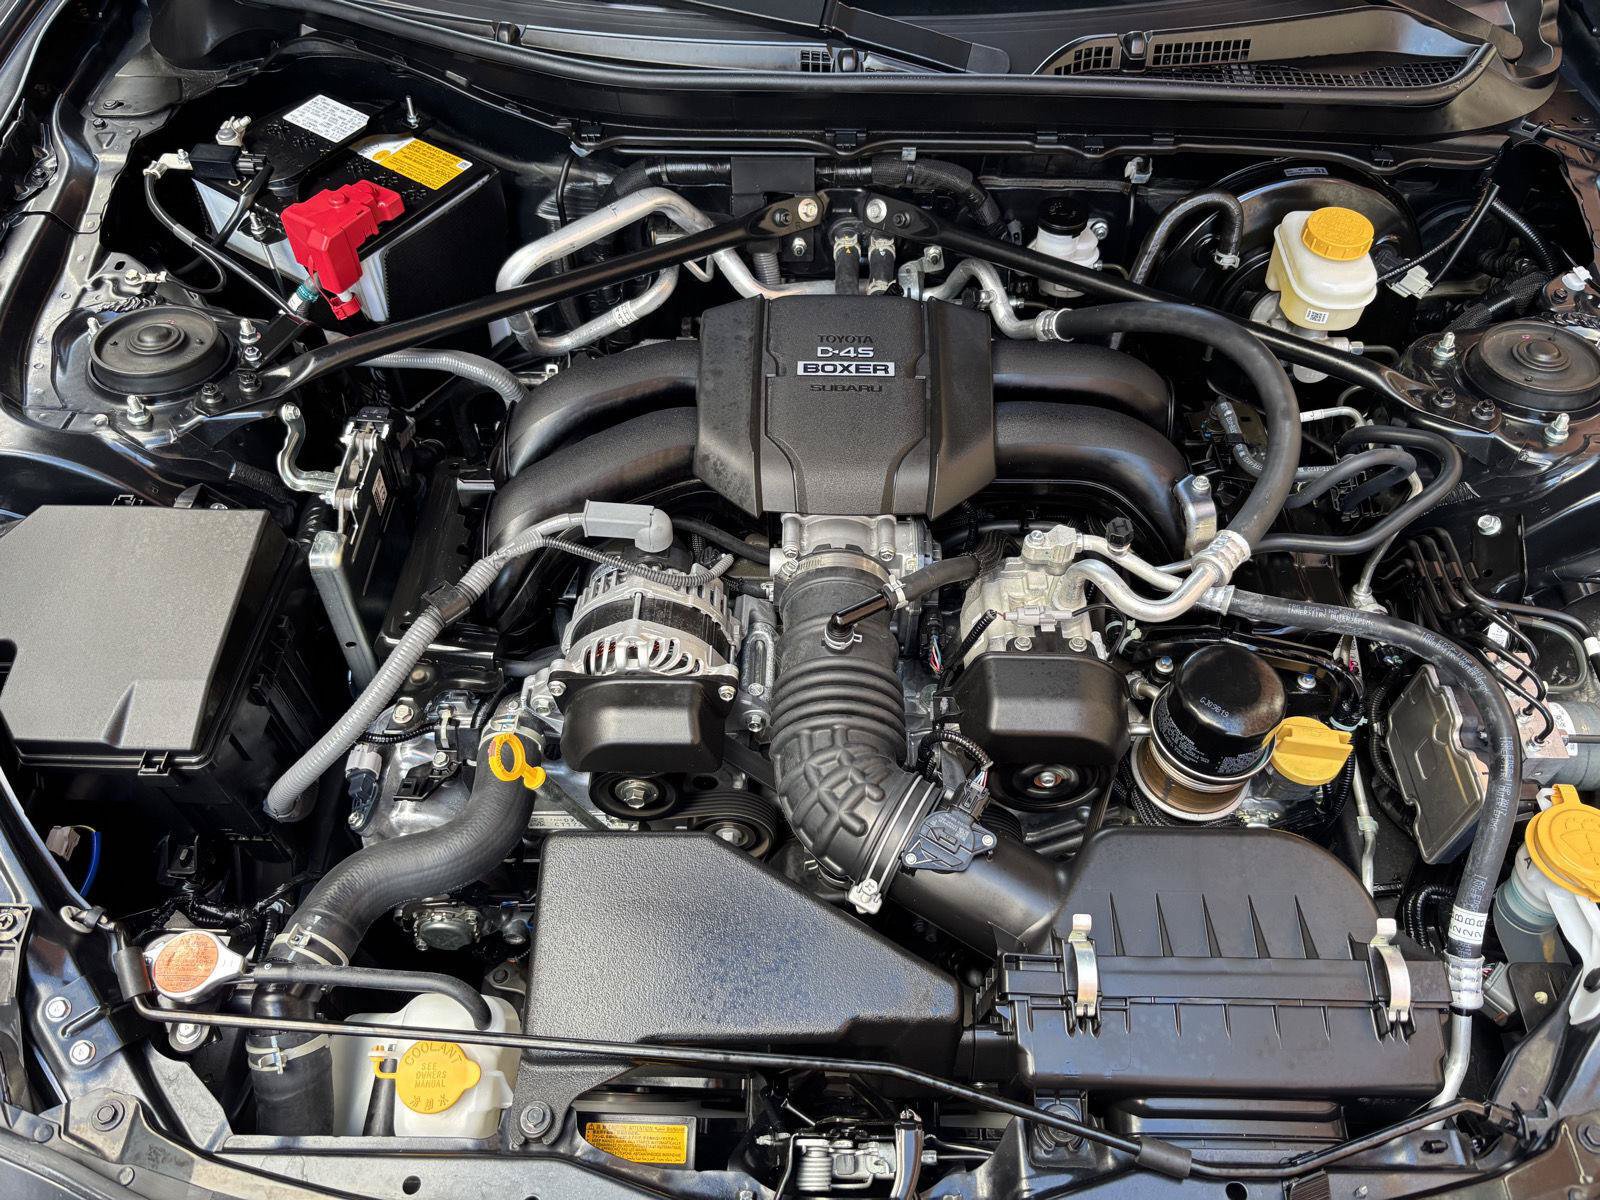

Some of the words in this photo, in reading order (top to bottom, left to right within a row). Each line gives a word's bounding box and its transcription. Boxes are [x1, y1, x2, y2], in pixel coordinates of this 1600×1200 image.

[817, 334, 874, 344] TOYOTA
[802, 362, 890, 375] BOXER
[809, 384, 882, 392] SUBARU
[404, 1042, 463, 1066] COOLANT
[421, 1063, 439, 1071] SEE
[416, 1071, 447, 1080] OWNERS
[414, 1080, 446, 1089] MANUAL
